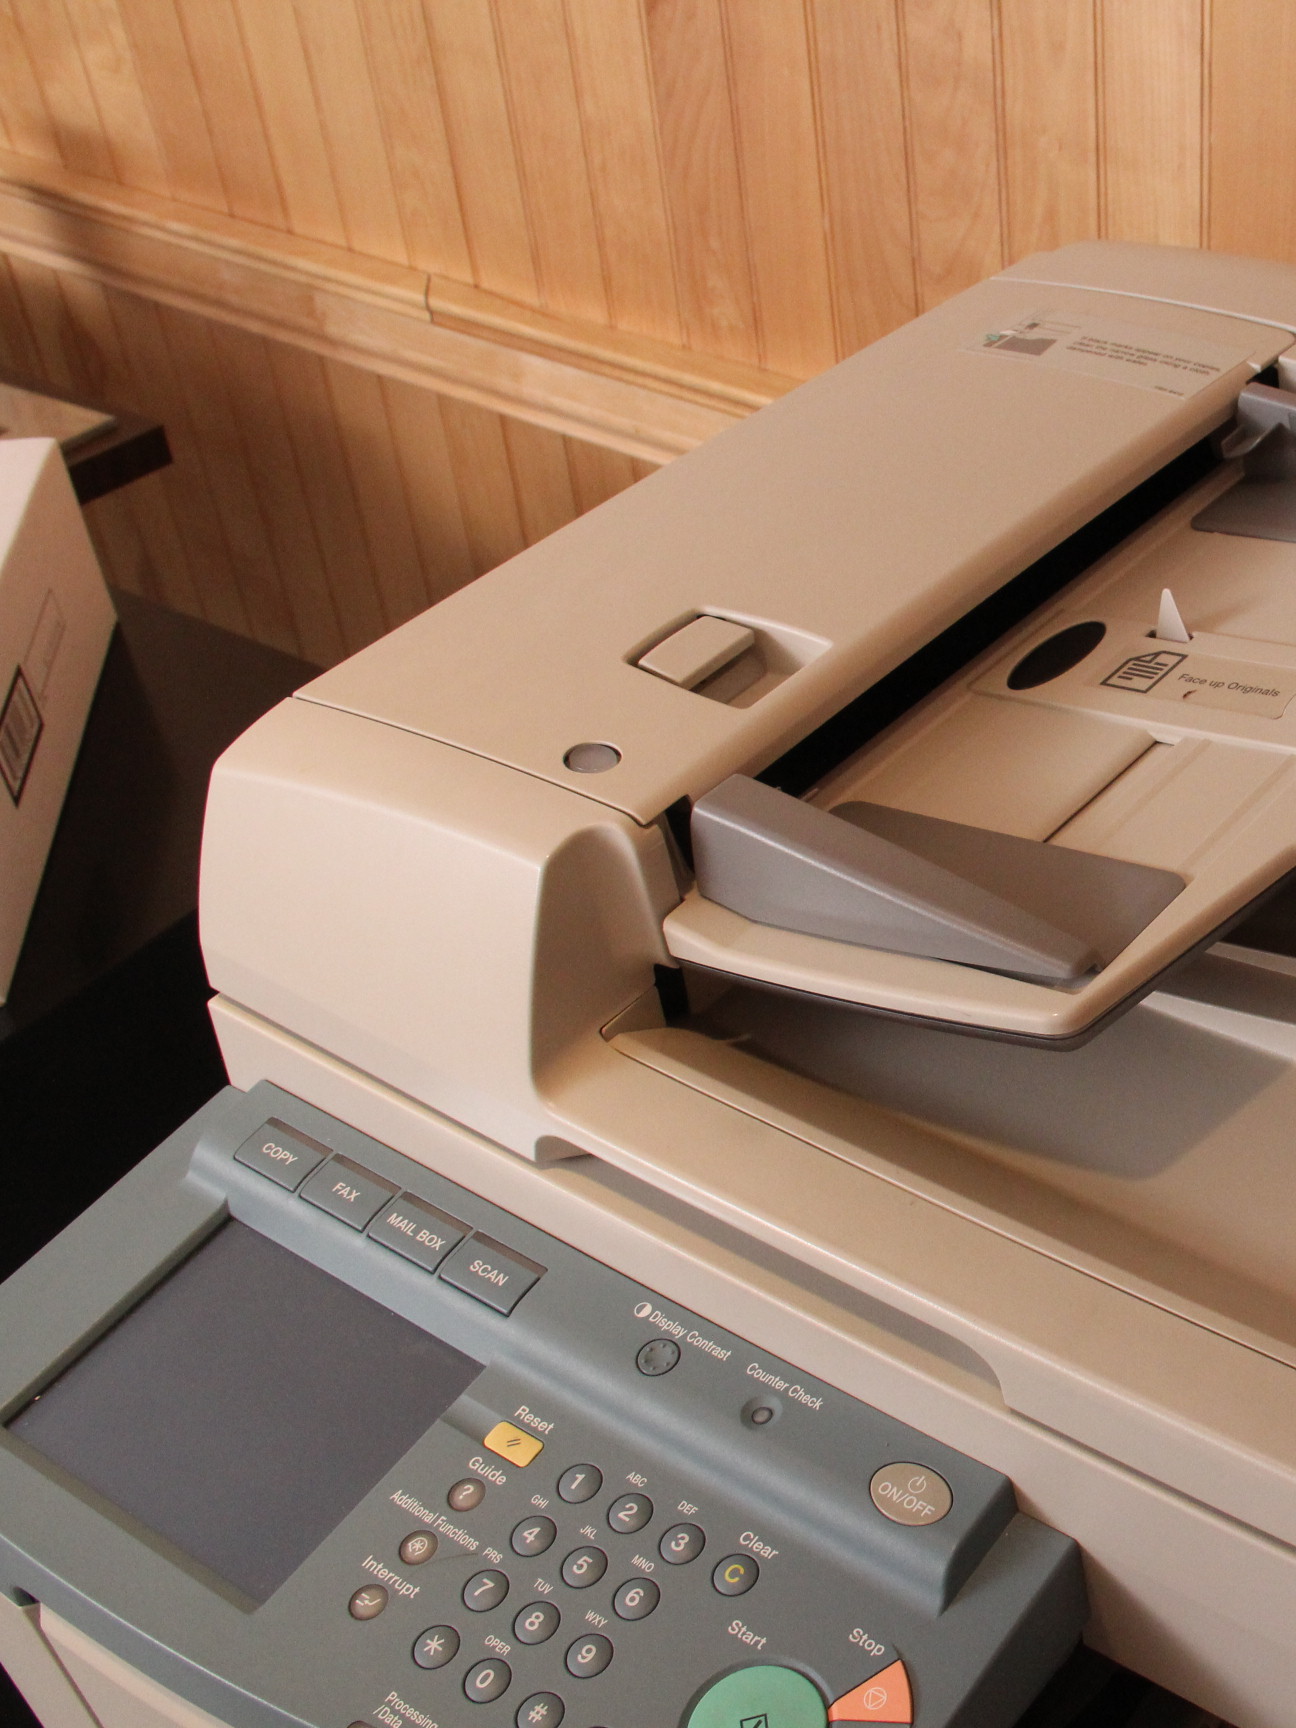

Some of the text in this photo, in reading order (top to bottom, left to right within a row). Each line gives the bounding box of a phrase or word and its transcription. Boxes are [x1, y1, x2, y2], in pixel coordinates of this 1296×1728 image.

[1178, 673, 1281, 698] Face up Originals
[262, 1142, 298, 1166] COPY
[332, 1181, 361, 1202] FAX
[387, 1213, 446, 1251] MAIL BOX
[470, 1260, 509, 1287] SCAN
[649, 1310, 731, 1362] Display Contrast
[746, 1363, 823, 1410] Counter Check
[514, 1405, 555, 1435] Reset
[468, 1456, 507, 1485] Guide
[626, 1471, 647, 1487] ABC
[570, 1474, 585, 1490] 1
[531, 1494, 549, 1510] GHI
[677, 1500, 698, 1516] DEF
[878, 1481, 935, 1519] ON/OFF
[390, 1489, 480, 1551] Additional Functions
[618, 1503, 638, 1521] 2
[522, 1527, 541, 1544] 4
[580, 1524, 598, 1540] JKL
[671, 1533, 689, 1551] 3
[739, 1531, 779, 1560] Clear
[483, 1547, 503, 1564] PRS
[573, 1556, 592, 1574] 5
[631, 1554, 655, 1573] MNO
[361, 1555, 421, 1599] Interrupt
[724, 1564, 745, 1583] C
[474, 1578, 495, 1596] 7
[534, 1578, 554, 1595] TUV
[625, 1588, 644, 1606] 6
[525, 1612, 544, 1630] 8
[585, 1610, 608, 1628] WXY
[728, 1620, 767, 1650] Start
[849, 1628, 885, 1656] Stop
[484, 1634, 511, 1656] OPER
[577, 1644, 596, 1663] 9
[476, 1669, 494, 1688] 0
